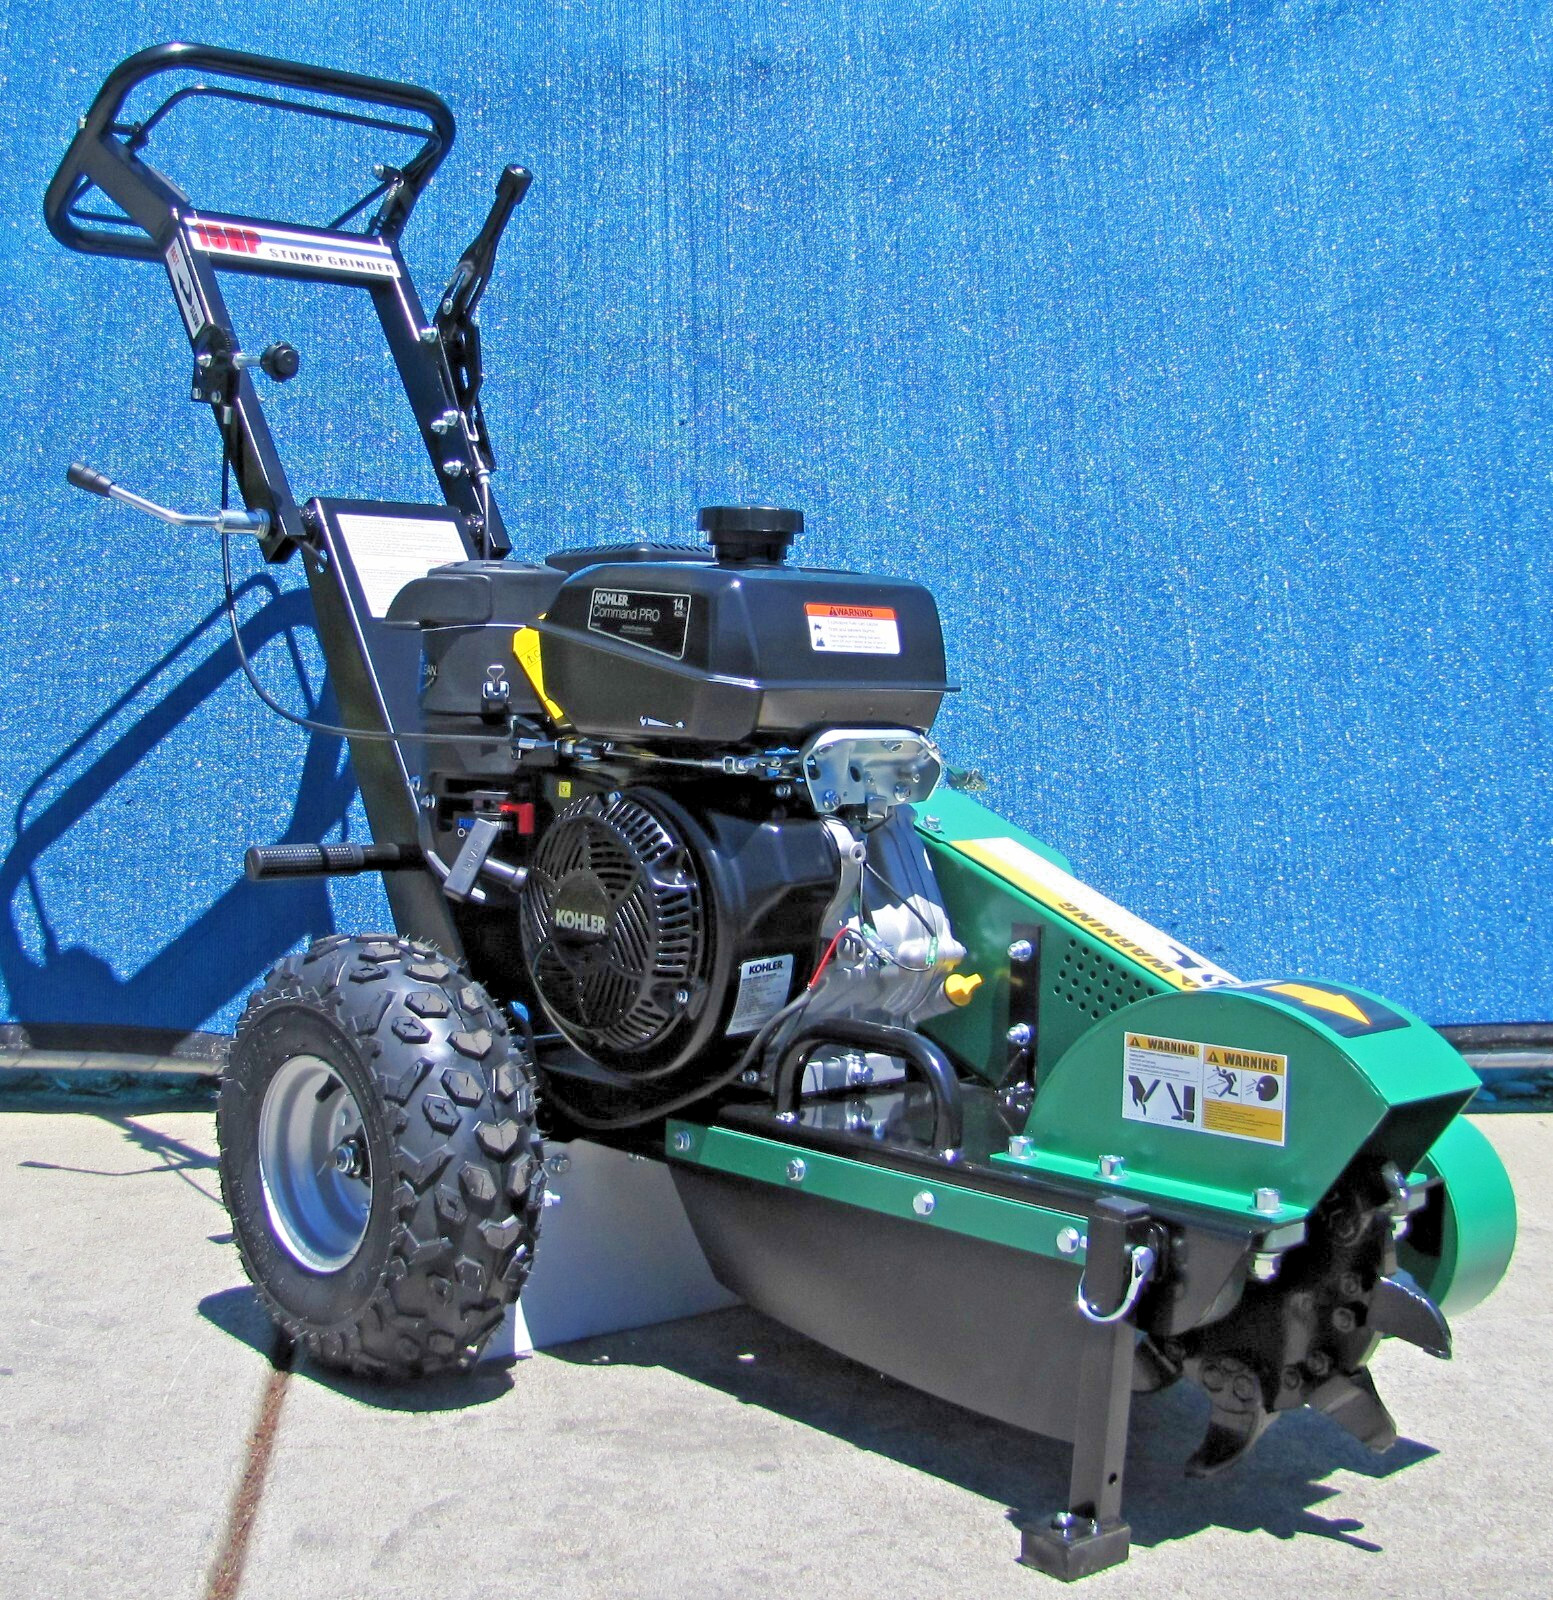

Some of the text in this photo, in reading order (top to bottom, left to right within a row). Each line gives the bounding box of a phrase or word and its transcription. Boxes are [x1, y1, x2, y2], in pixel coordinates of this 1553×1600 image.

[269, 248, 323, 264] STUMP
[328, 256, 395, 273] GRINDER
[594, 592, 629, 606] KOHLER
[673, 598, 684, 611] 14
[592, 605, 637, 620] Command
[639, 608, 660, 622] PRO
[837, 607, 873, 617] WARNING
[555, 908, 607, 935] KOHLER
[1058, 902, 1175, 974] WARNING
[748, 960, 783, 975] KOHLER
[1147, 1038, 1196, 1056] WARNING
[1224, 1052, 1279, 1072] WARNING
